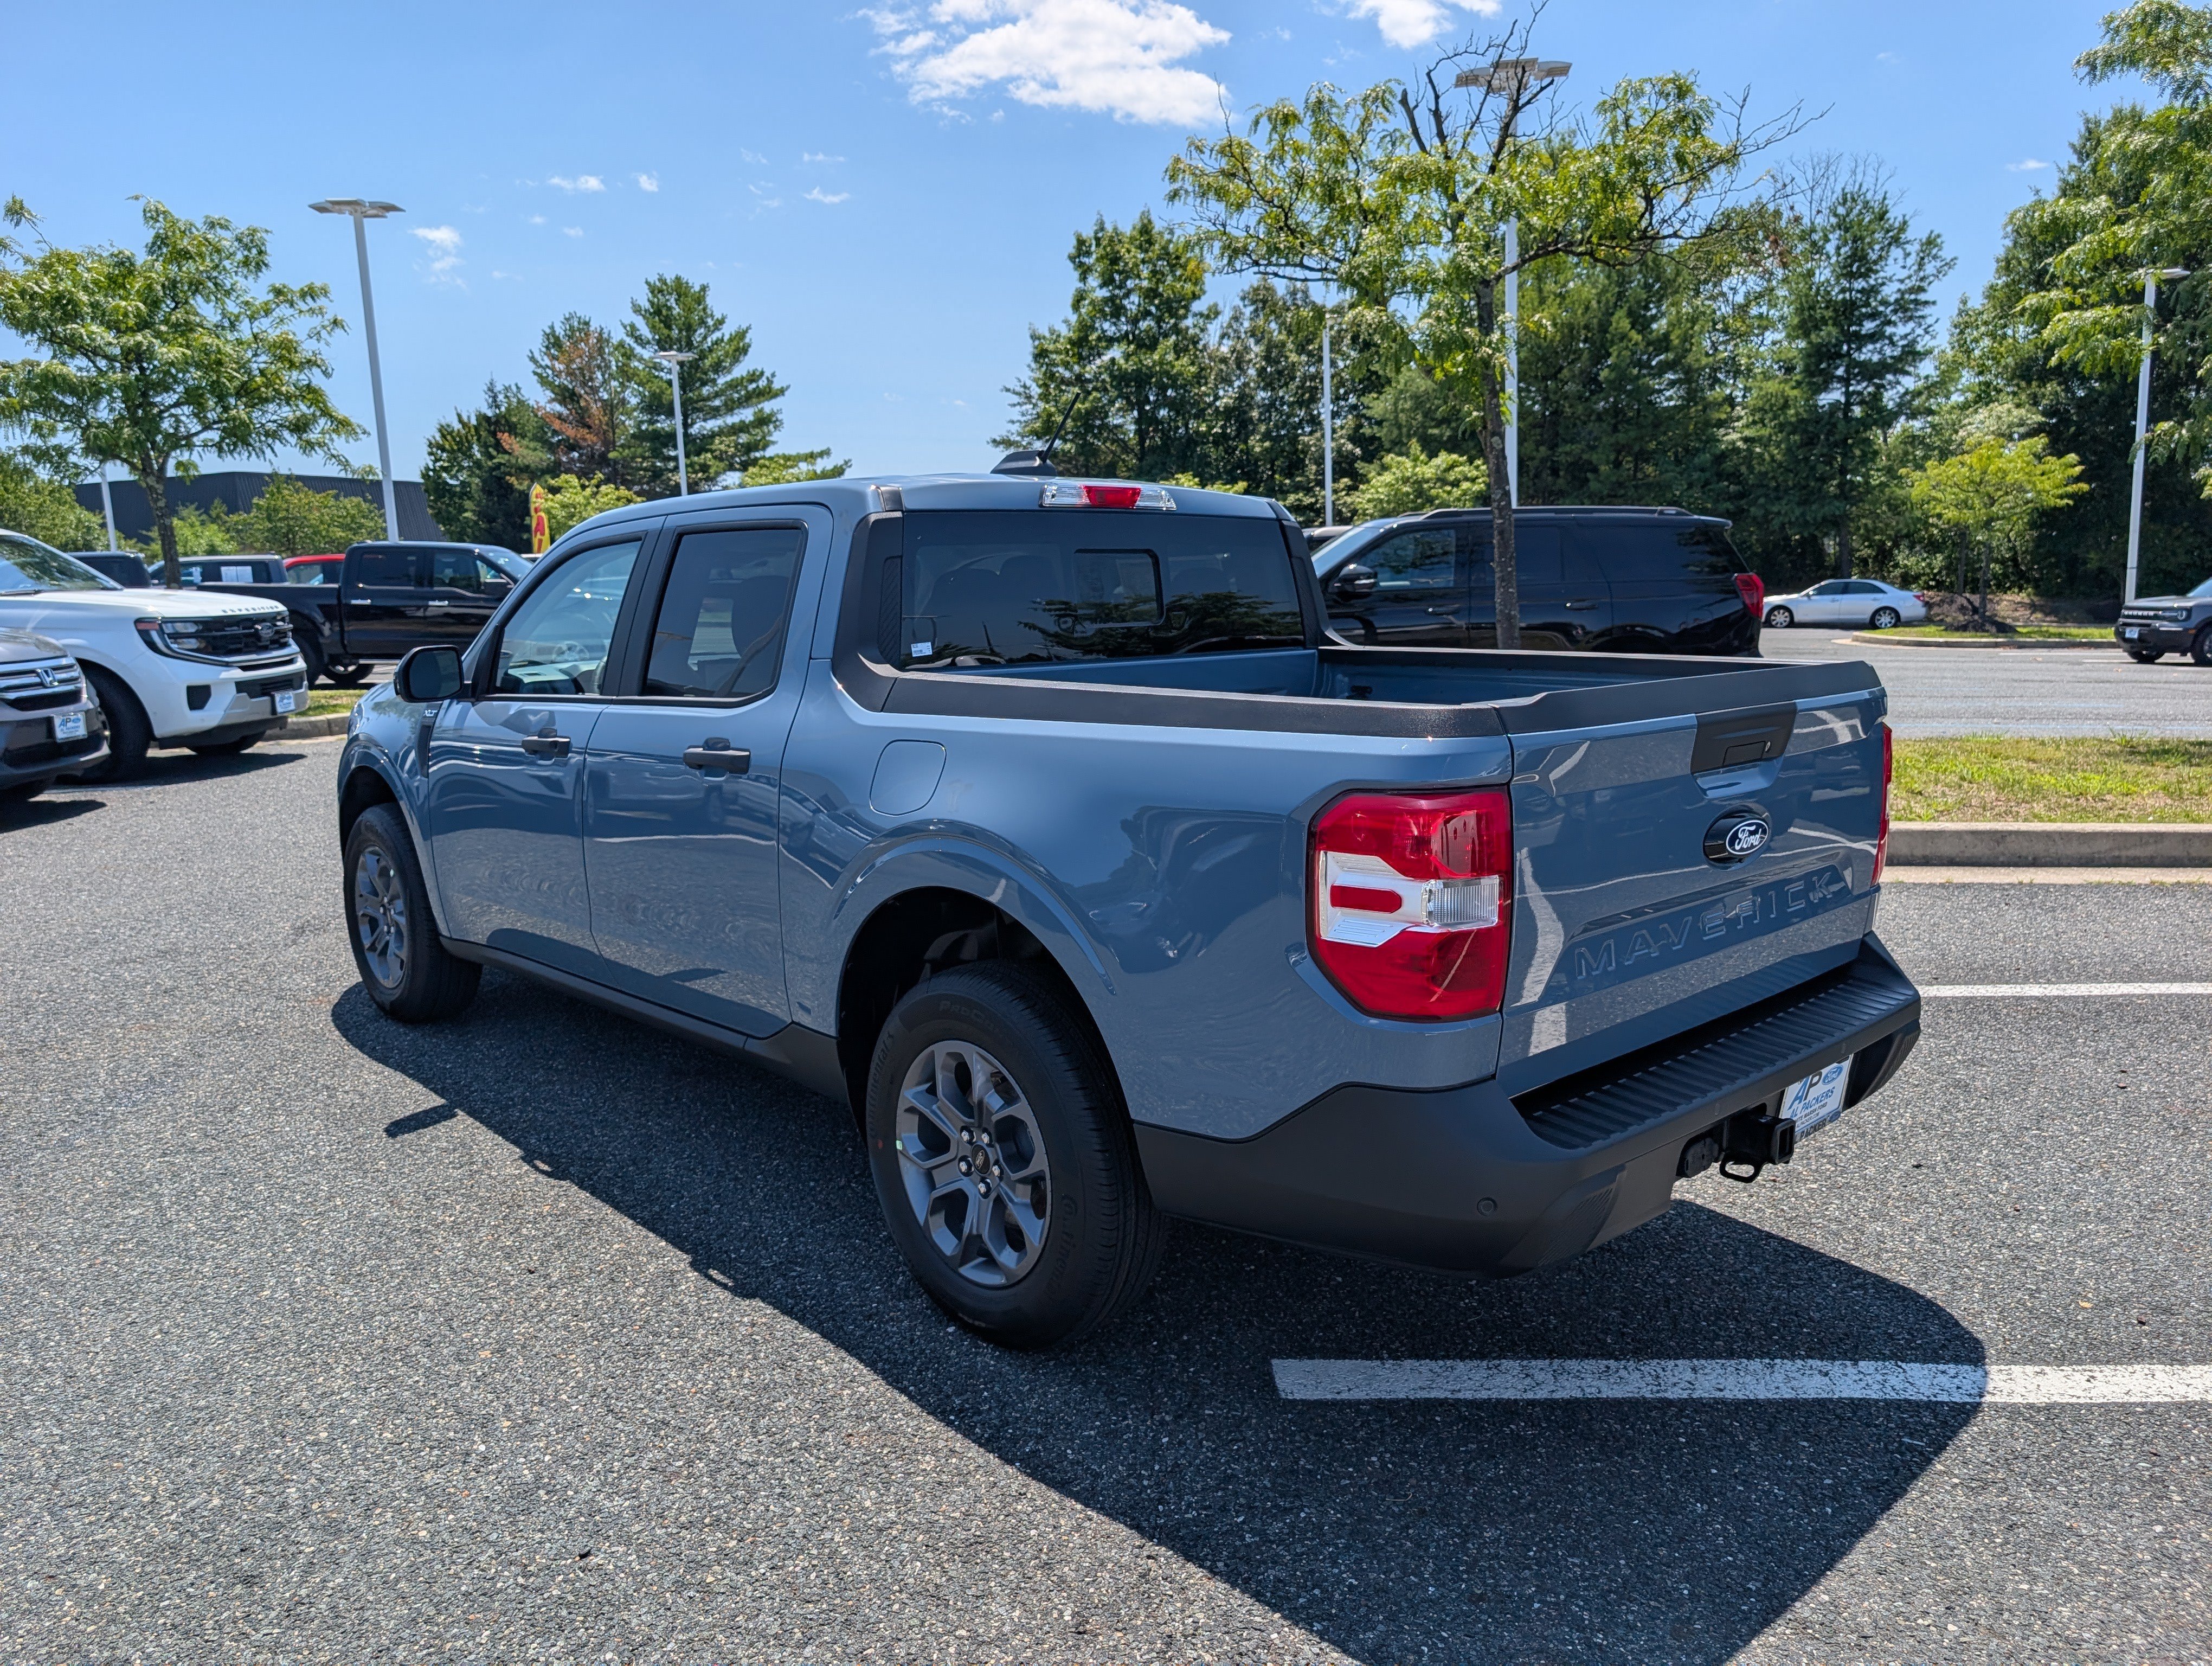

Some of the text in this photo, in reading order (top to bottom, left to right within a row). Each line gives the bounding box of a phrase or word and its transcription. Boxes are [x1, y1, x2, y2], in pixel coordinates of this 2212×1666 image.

[1734, 824, 1763, 850] Ford
[1573, 872, 1833, 979] MAVERICK
[1787, 1071, 1823, 1111] AP
[1800, 1086, 1836, 1114] PACKERS
